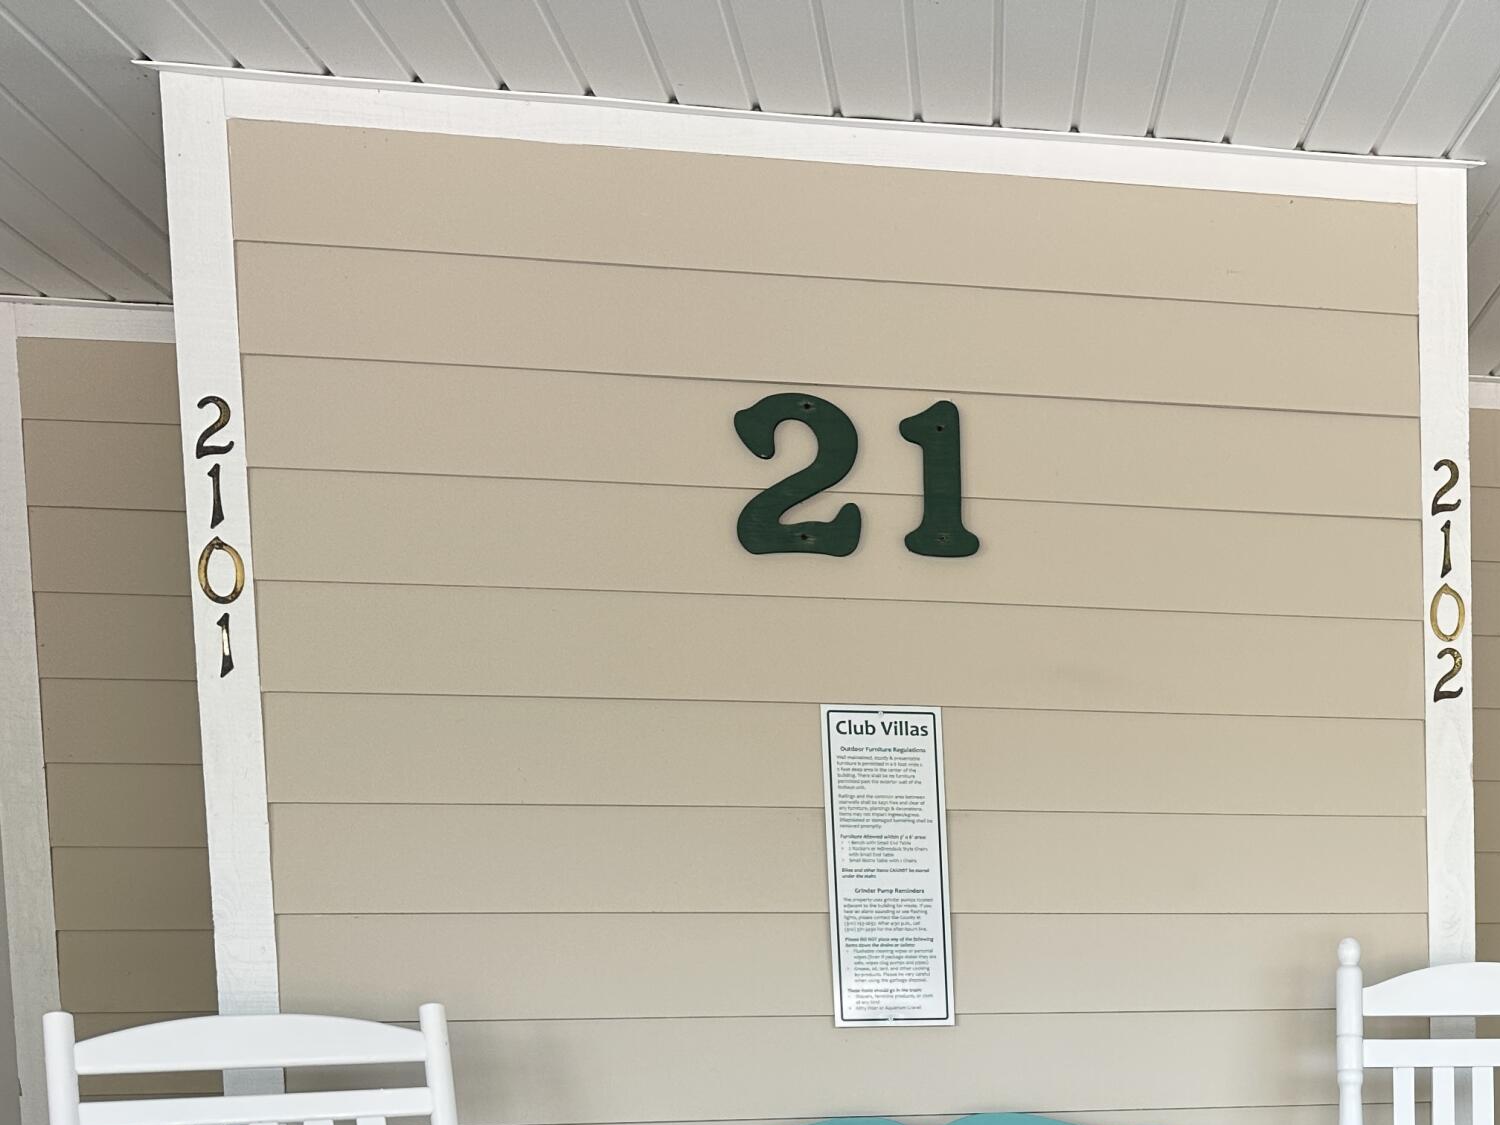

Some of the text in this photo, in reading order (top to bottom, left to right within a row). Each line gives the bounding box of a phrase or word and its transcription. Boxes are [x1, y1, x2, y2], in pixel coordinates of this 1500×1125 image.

[195, 395, 245, 678] 2101
[734, 393, 980, 557] 21
[1430, 459, 1465, 702] 2102
[836, 720, 929, 737] Club Villas
